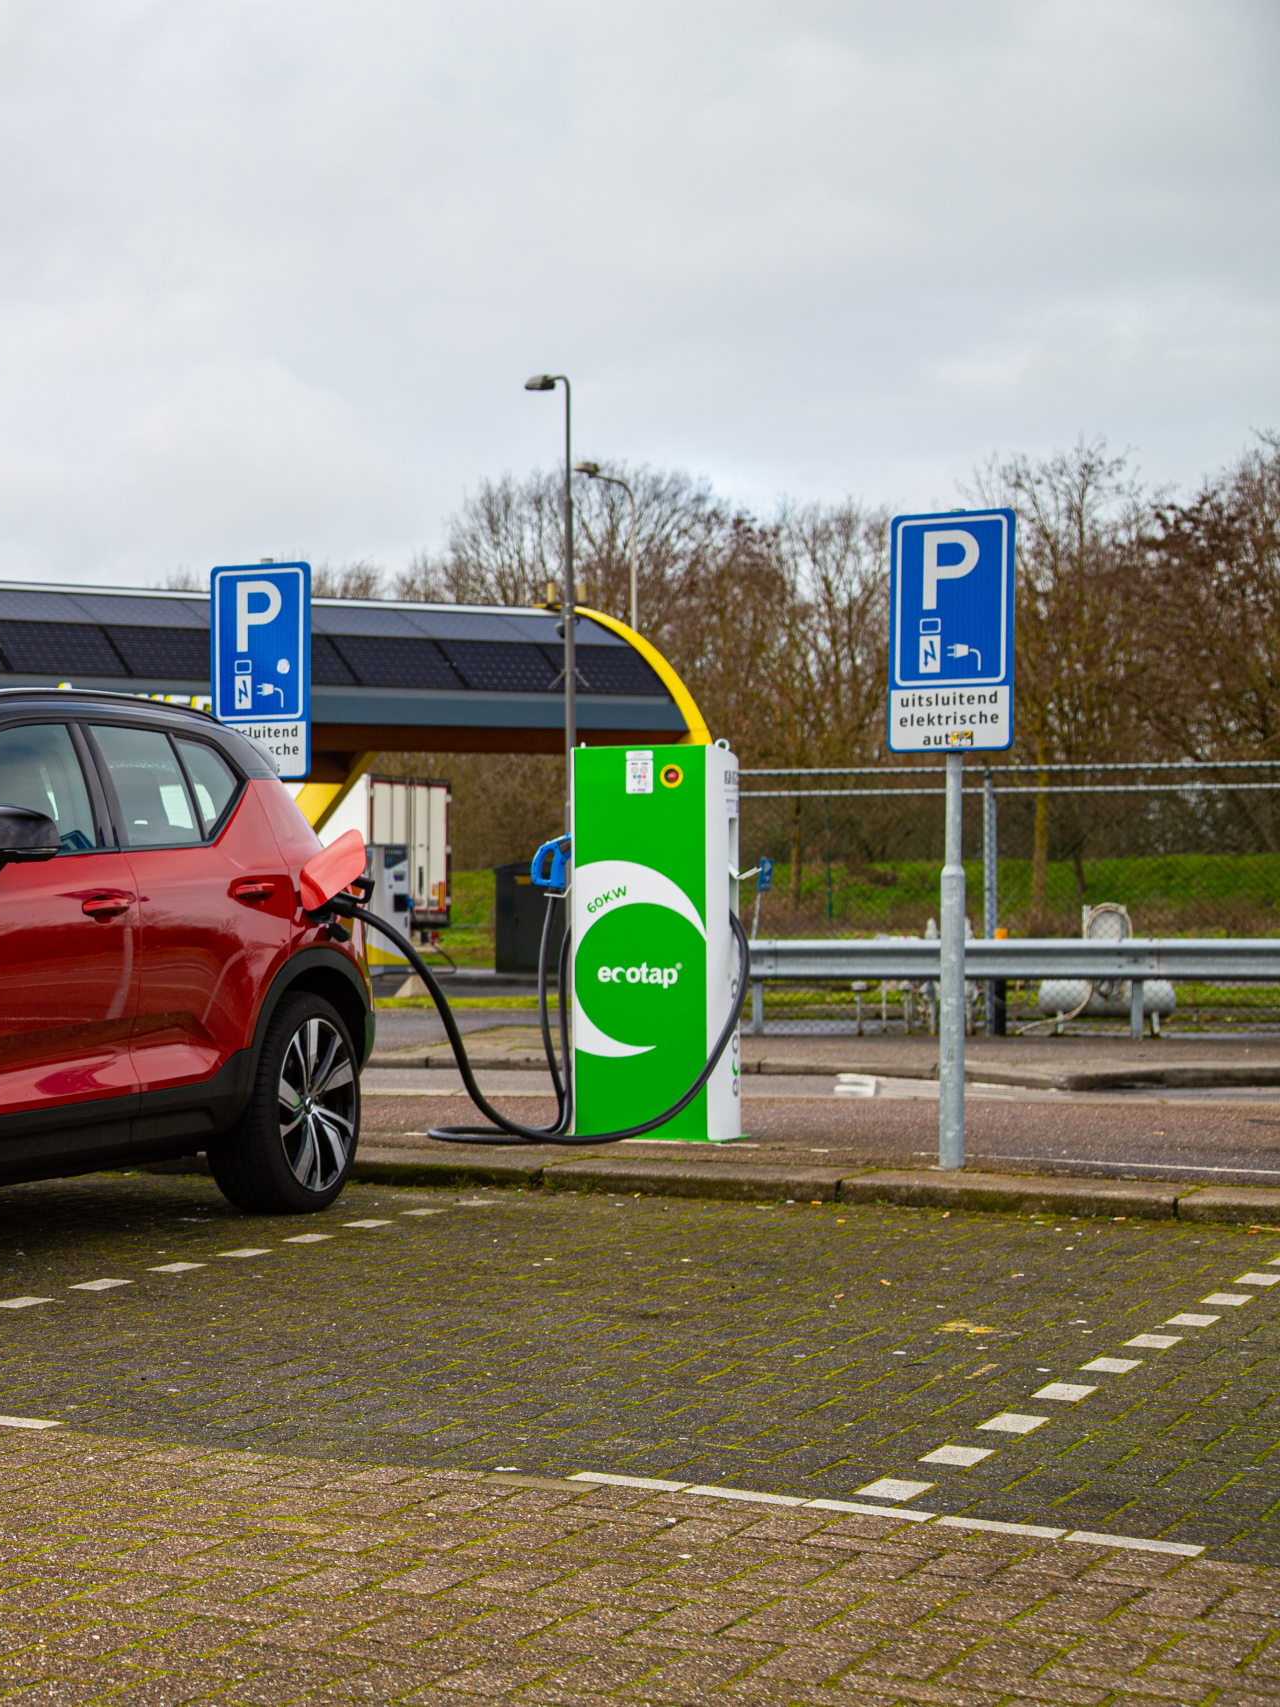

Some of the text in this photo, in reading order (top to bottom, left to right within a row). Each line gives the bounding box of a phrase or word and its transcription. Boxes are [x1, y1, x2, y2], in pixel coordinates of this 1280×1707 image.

[923, 529, 980, 610] P
[236, 580, 282, 653] P
[900, 690, 998, 708] uitsluitend
[900, 710, 999, 727] elektrische
[231, 725, 298, 738] luitend
[587, 885, 627, 913] 60KW
